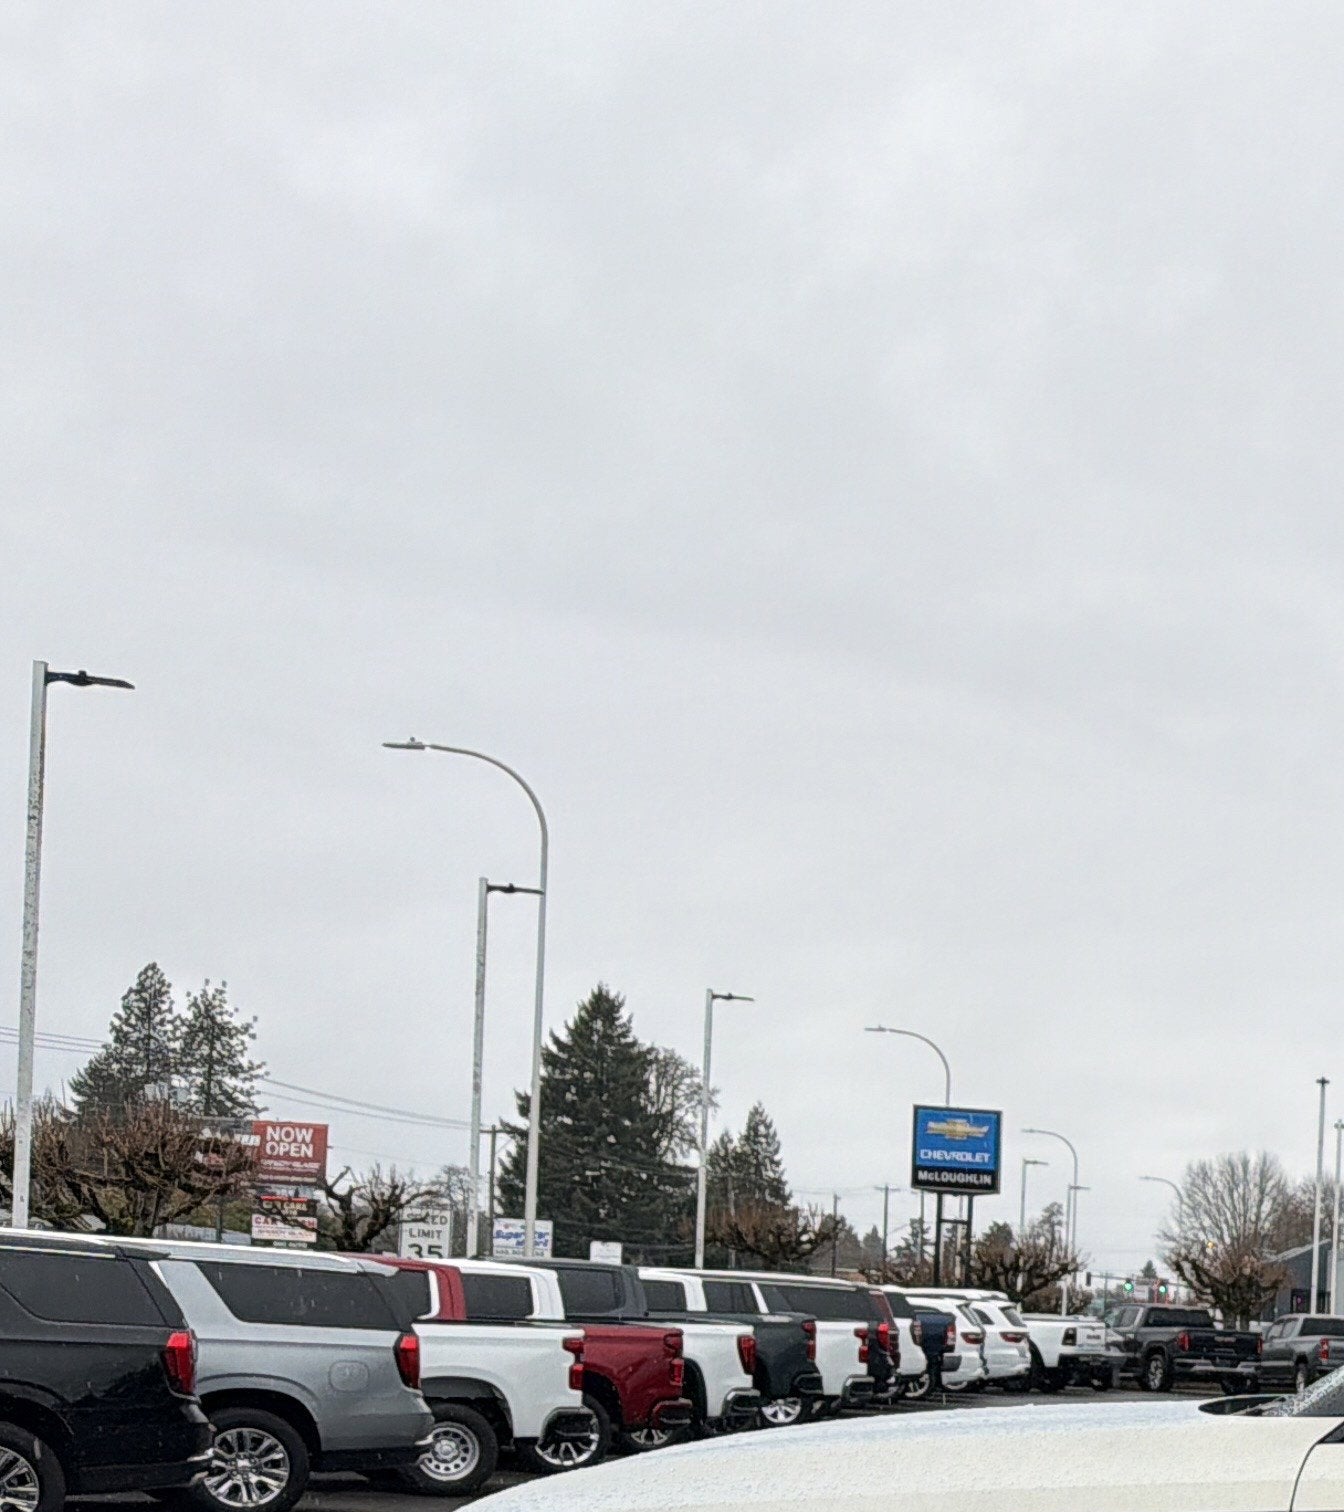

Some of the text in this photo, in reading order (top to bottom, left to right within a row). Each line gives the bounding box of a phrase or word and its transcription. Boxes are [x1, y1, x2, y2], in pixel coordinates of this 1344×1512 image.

[266, 1125, 314, 1144] NOW
[265, 1141, 314, 1158] OPEN
[920, 1149, 991, 1163] CHEVROLET
[917, 1170, 992, 1185] McLOUGHLIN
[408, 1228, 443, 1239] LIMIT
[408, 1243, 444, 1259] 35
